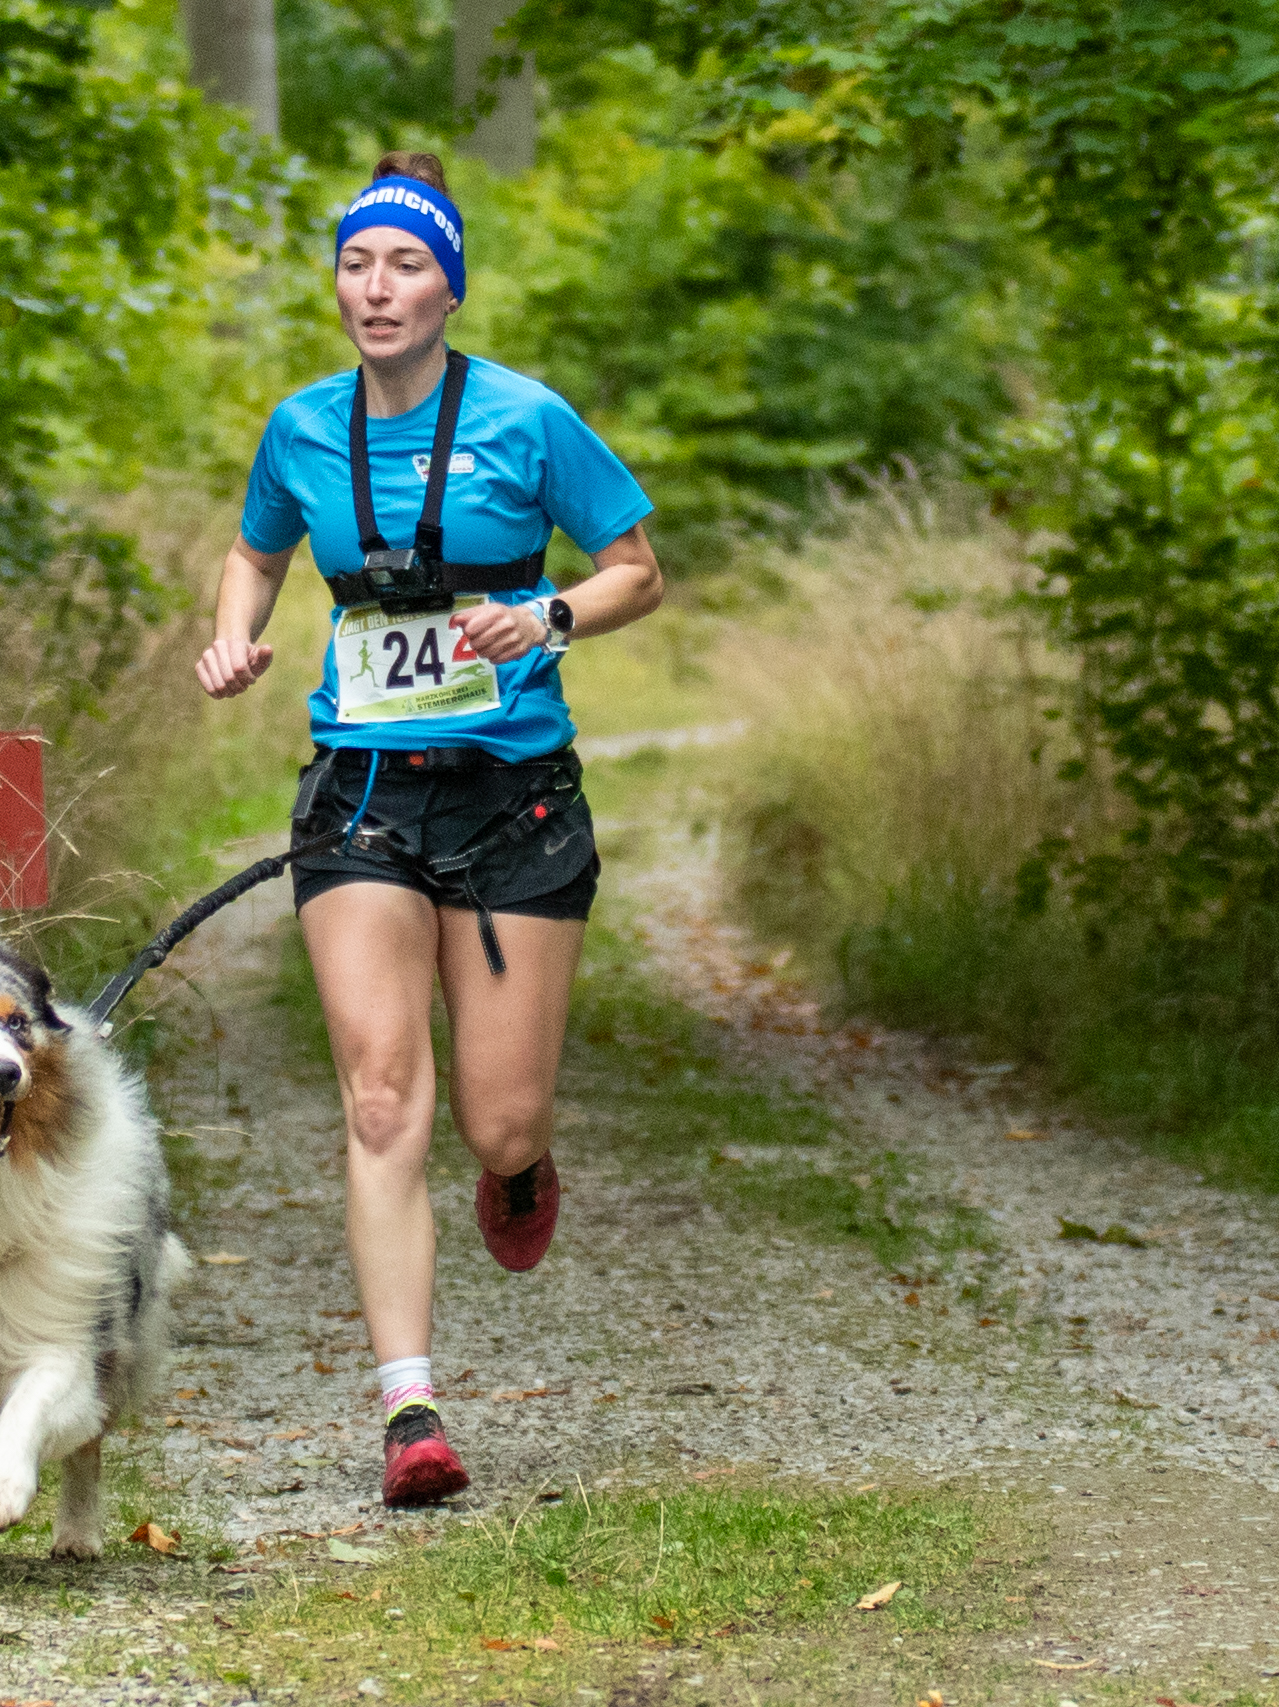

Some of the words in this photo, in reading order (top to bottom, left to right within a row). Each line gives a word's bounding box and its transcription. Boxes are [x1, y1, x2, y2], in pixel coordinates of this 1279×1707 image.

[342, 619, 365, 636] JAGT
[366, 612, 389, 630] DEN
[448, 614, 478, 662] 2
[382, 627, 446, 690] 24
[417, 687, 487, 711] STEMBERGHAUS
